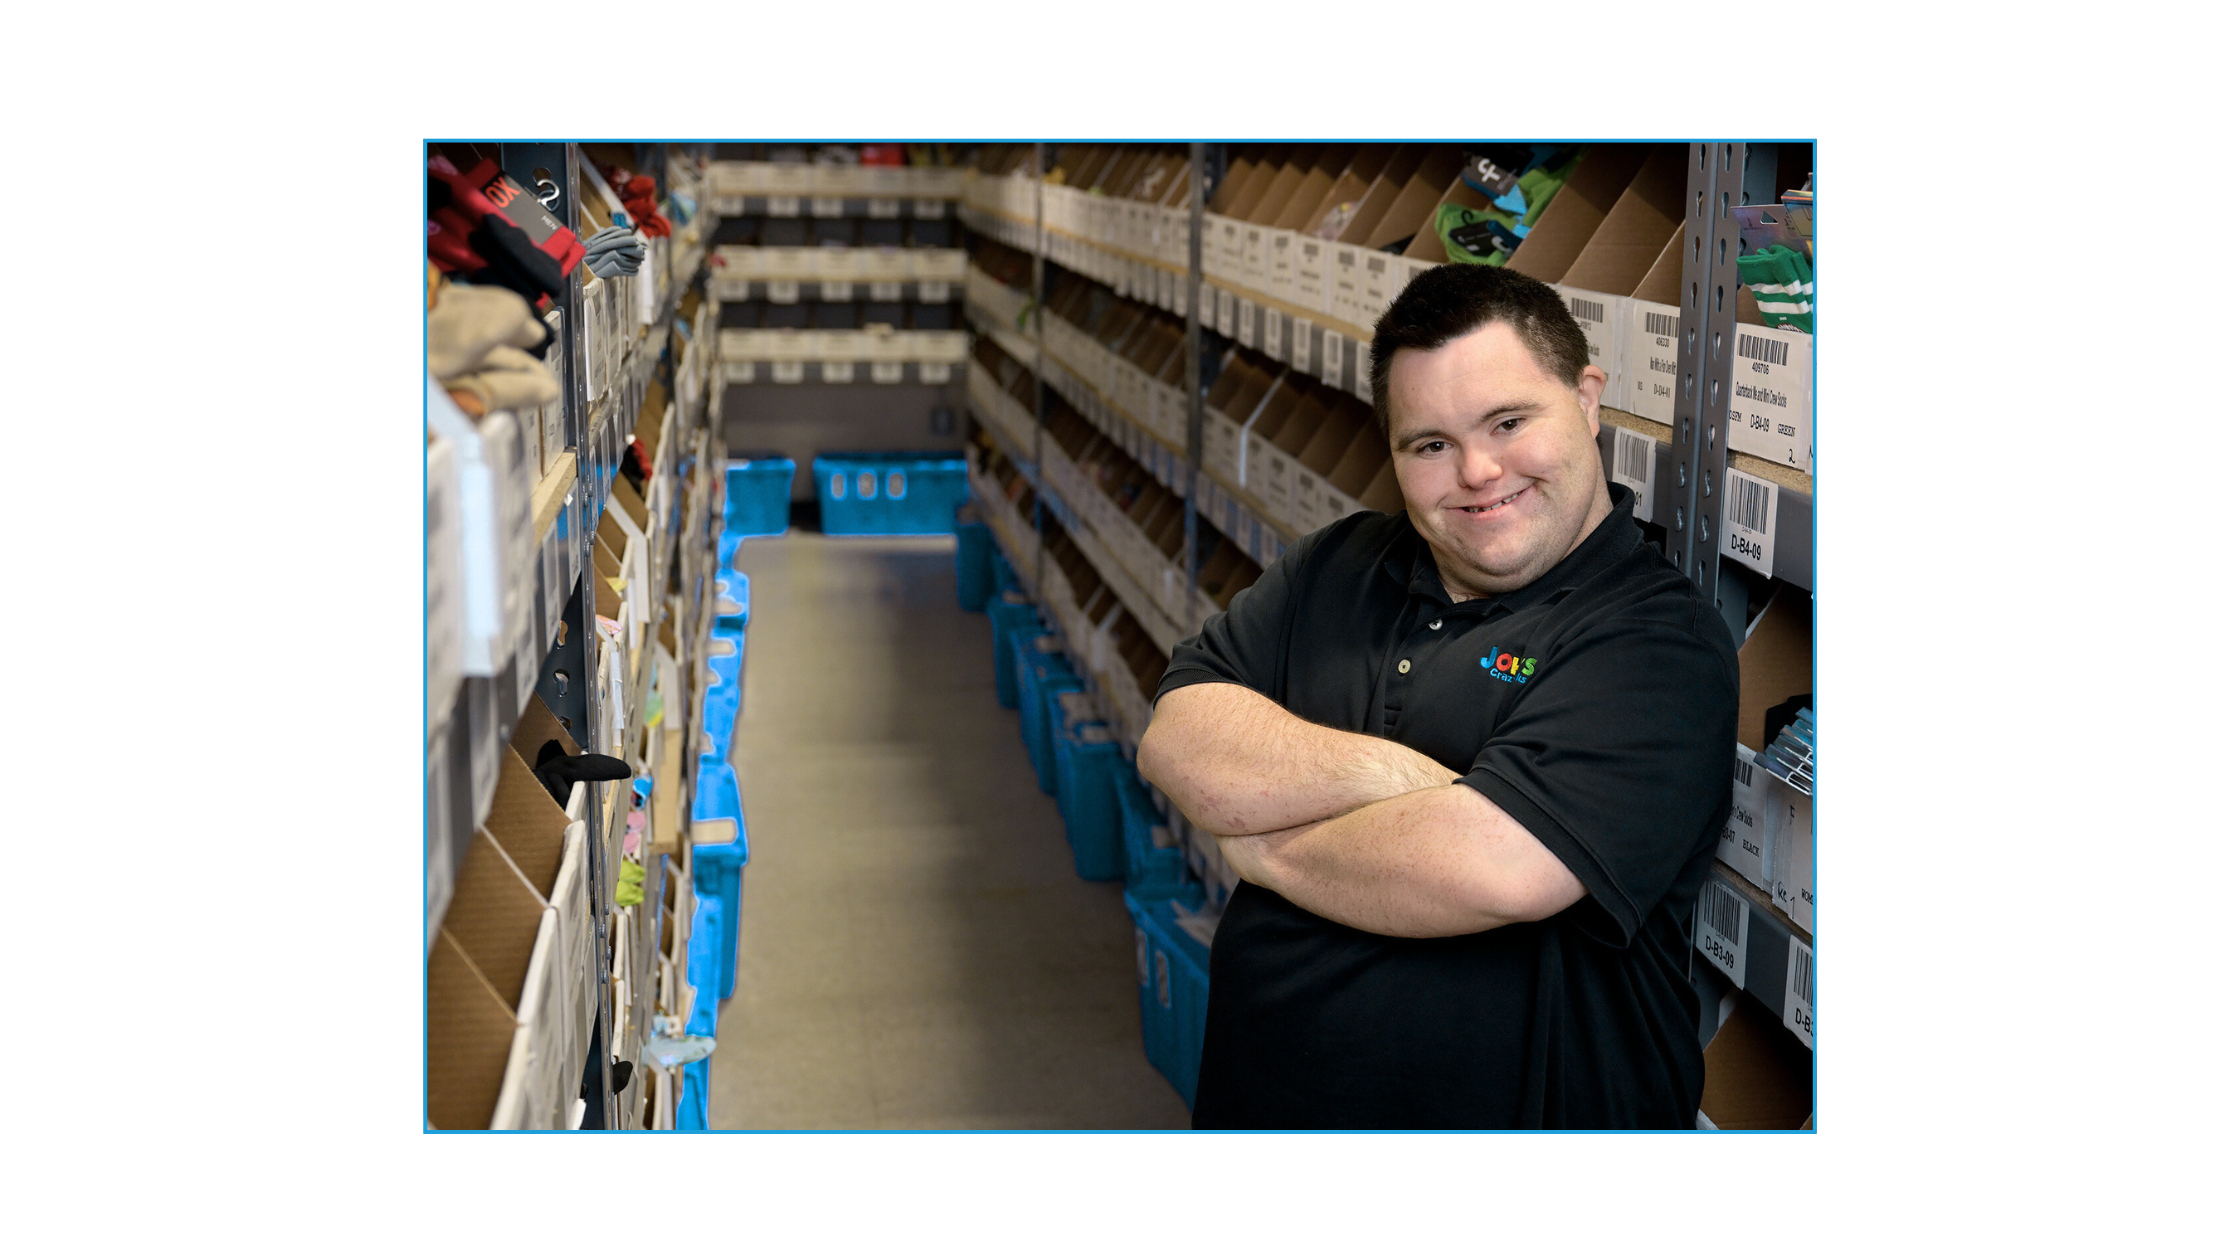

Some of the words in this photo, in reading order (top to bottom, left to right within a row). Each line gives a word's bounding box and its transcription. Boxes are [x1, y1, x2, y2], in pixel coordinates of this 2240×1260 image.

[1752, 362, 1769, 374] 409706
[1769, 389, 1778, 405] Crew
[1778, 392, 1787, 407] Socks
[1750, 414, 1770, 432] D-B4-09
[1777, 423, 1796, 437] GREEN
[1731, 533, 1762, 561] D-B4-09
[1742, 838, 1760, 858] BLACK
[1705, 934, 1734, 969] D-B3-09
